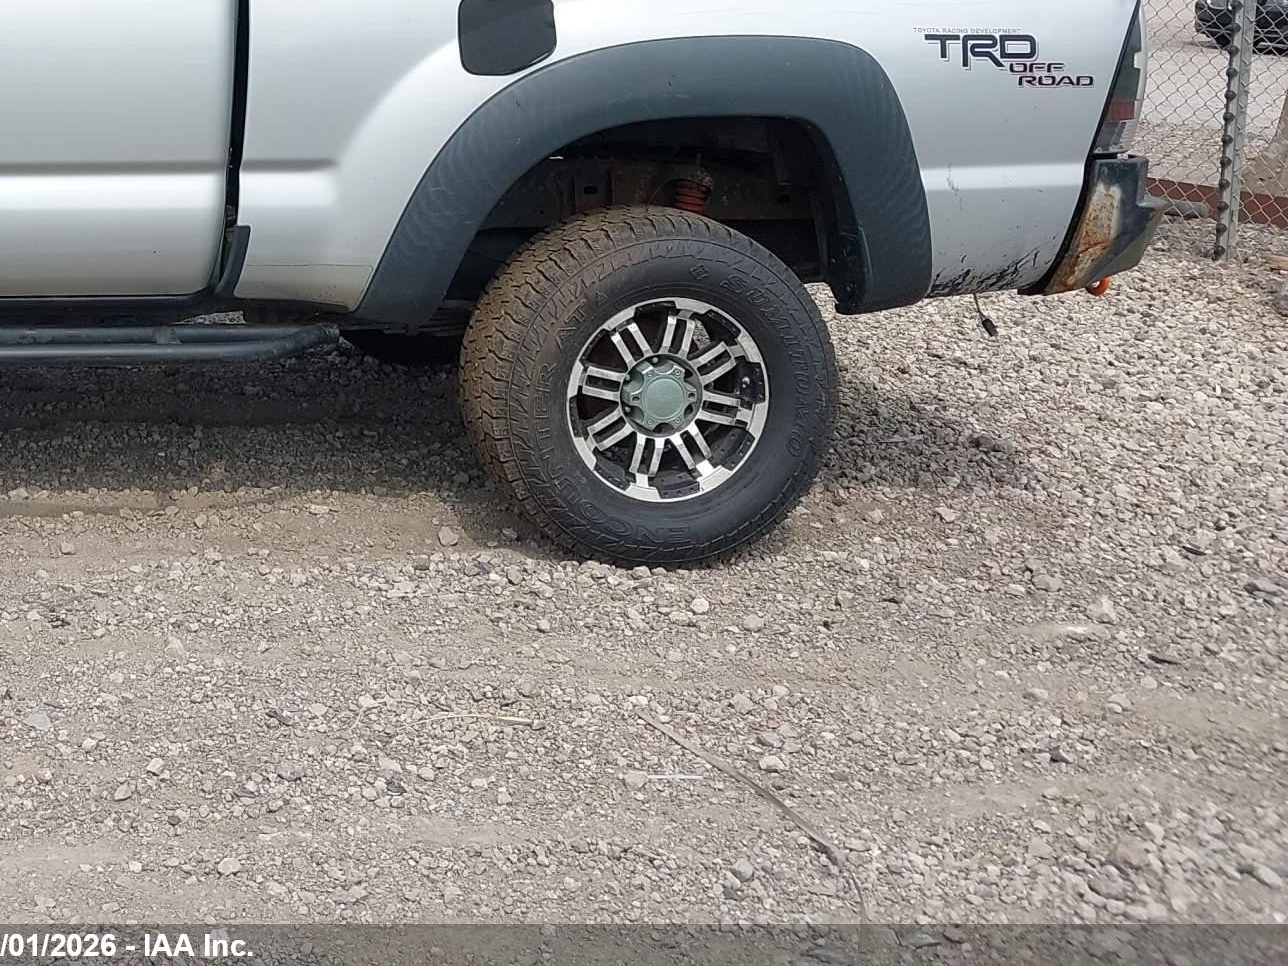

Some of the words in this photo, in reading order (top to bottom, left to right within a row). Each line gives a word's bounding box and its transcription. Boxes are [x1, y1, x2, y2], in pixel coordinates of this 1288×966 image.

[924, 33, 1039, 70] TRD
[1009, 62, 1065, 74] OFF
[1017, 75, 1095, 87] ROAD
[719, 273, 810, 458] SUMITOMO
[535, 362, 691, 542] ENCOUNTER
